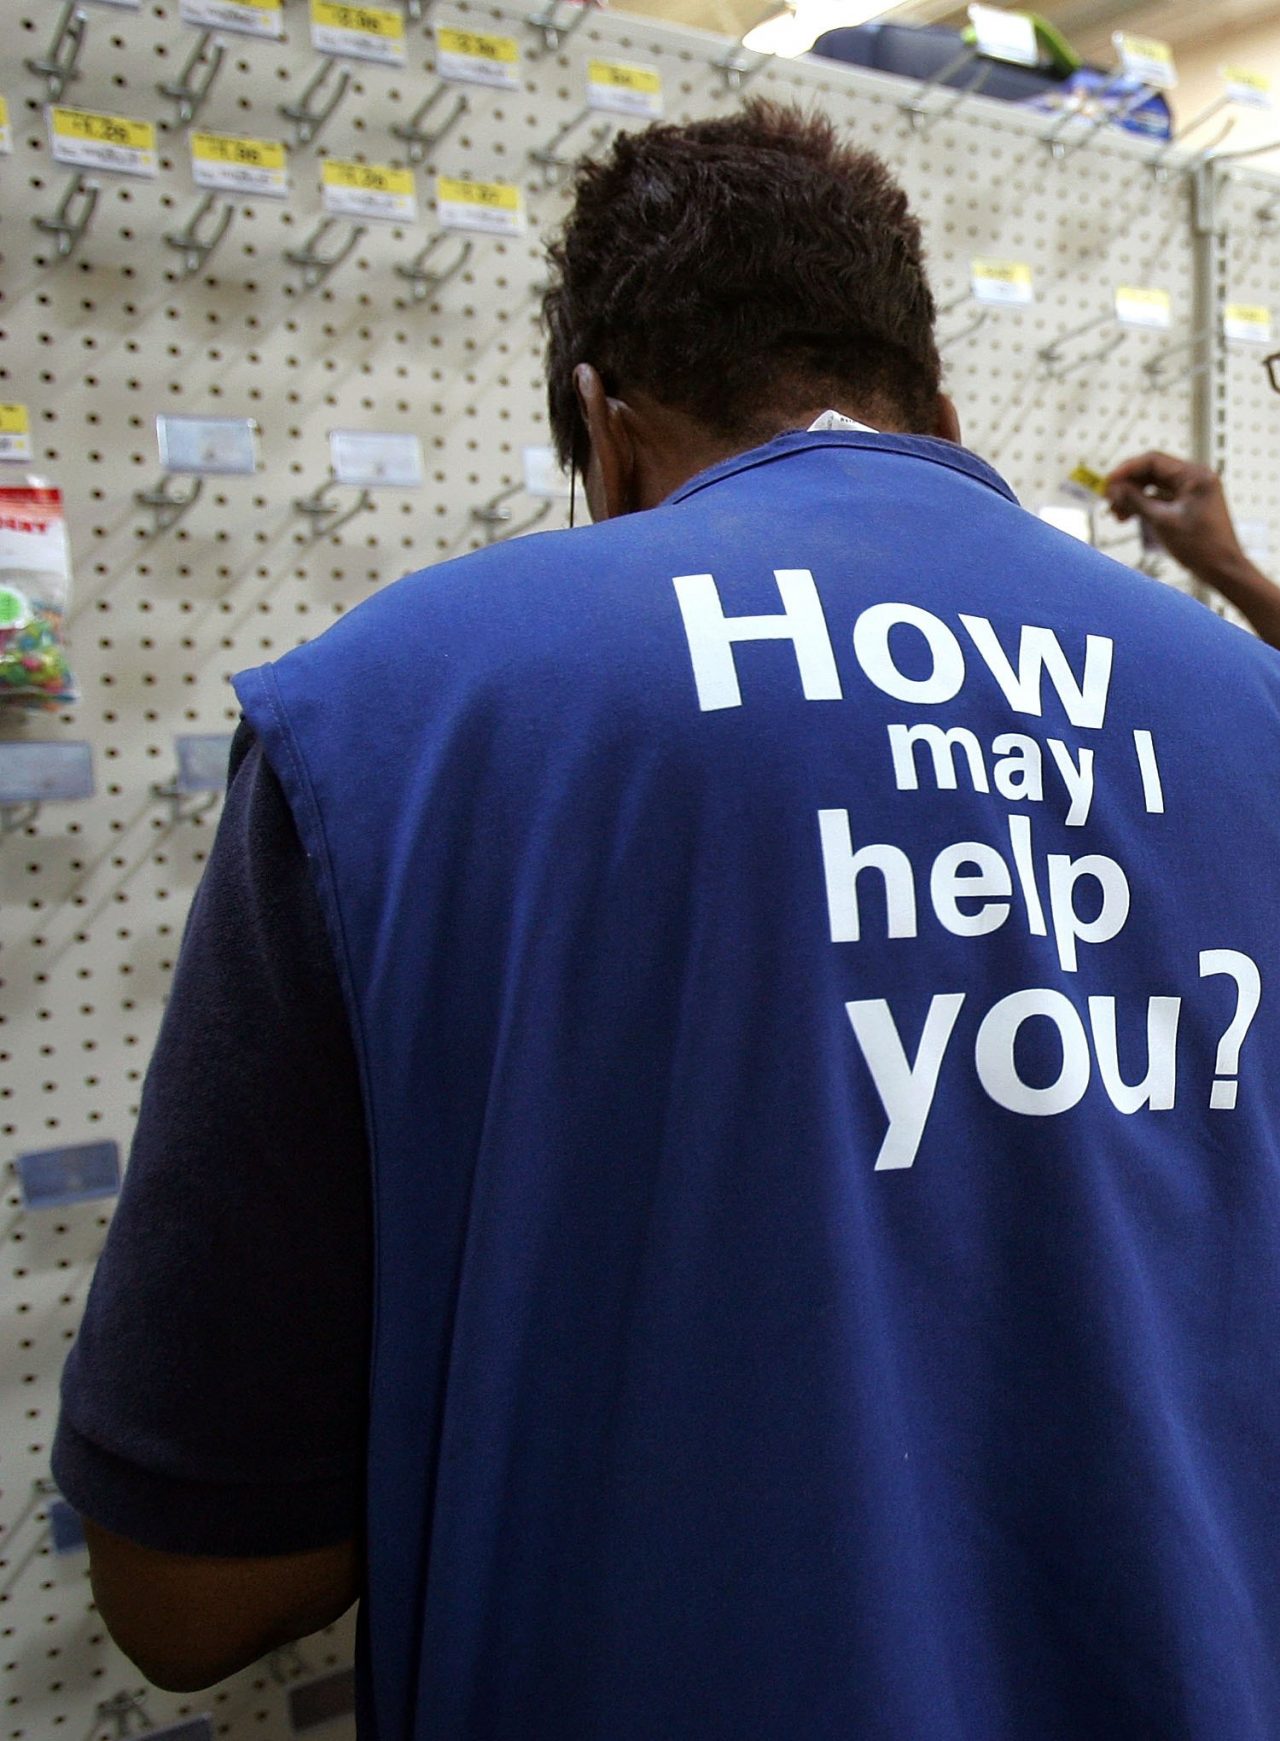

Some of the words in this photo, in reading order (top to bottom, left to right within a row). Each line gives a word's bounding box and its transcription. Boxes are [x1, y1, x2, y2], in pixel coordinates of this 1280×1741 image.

[672, 569, 1113, 729] How
[887, 724, 1094, 826] may
[1133, 729, 1165, 814] I
[818, 809, 1130, 972] help
[845, 949, 1262, 1171] you?
